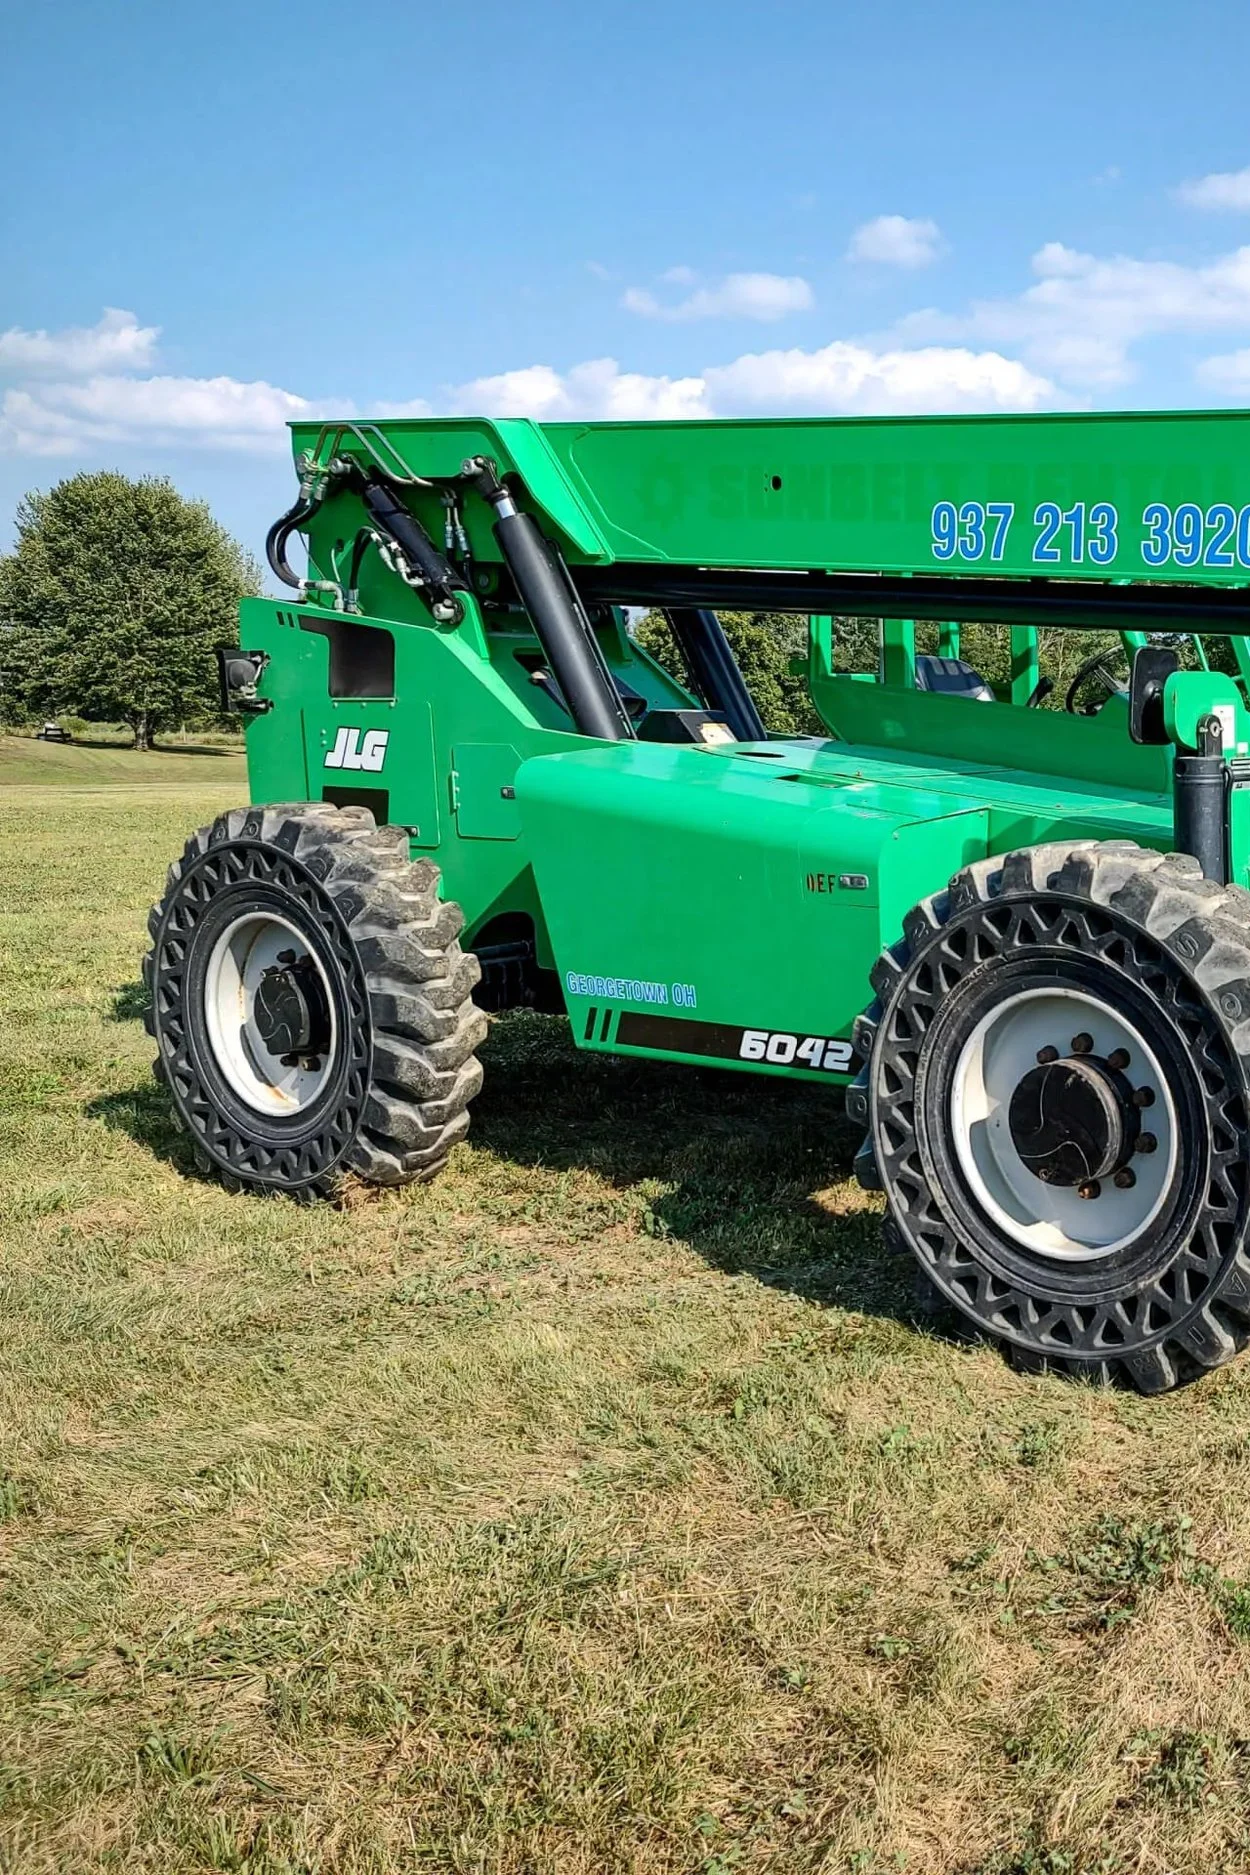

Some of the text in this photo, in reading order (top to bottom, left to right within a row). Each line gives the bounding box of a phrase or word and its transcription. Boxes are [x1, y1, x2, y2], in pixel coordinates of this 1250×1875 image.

[931, 500, 1015, 562] 937
[1032, 501, 1119, 565] 213
[323, 726, 391, 773] JLG
[806, 872, 836, 894] DEF
[565, 970, 697, 1008] GEORGETOWN OH
[738, 1029, 854, 1072] 6042
